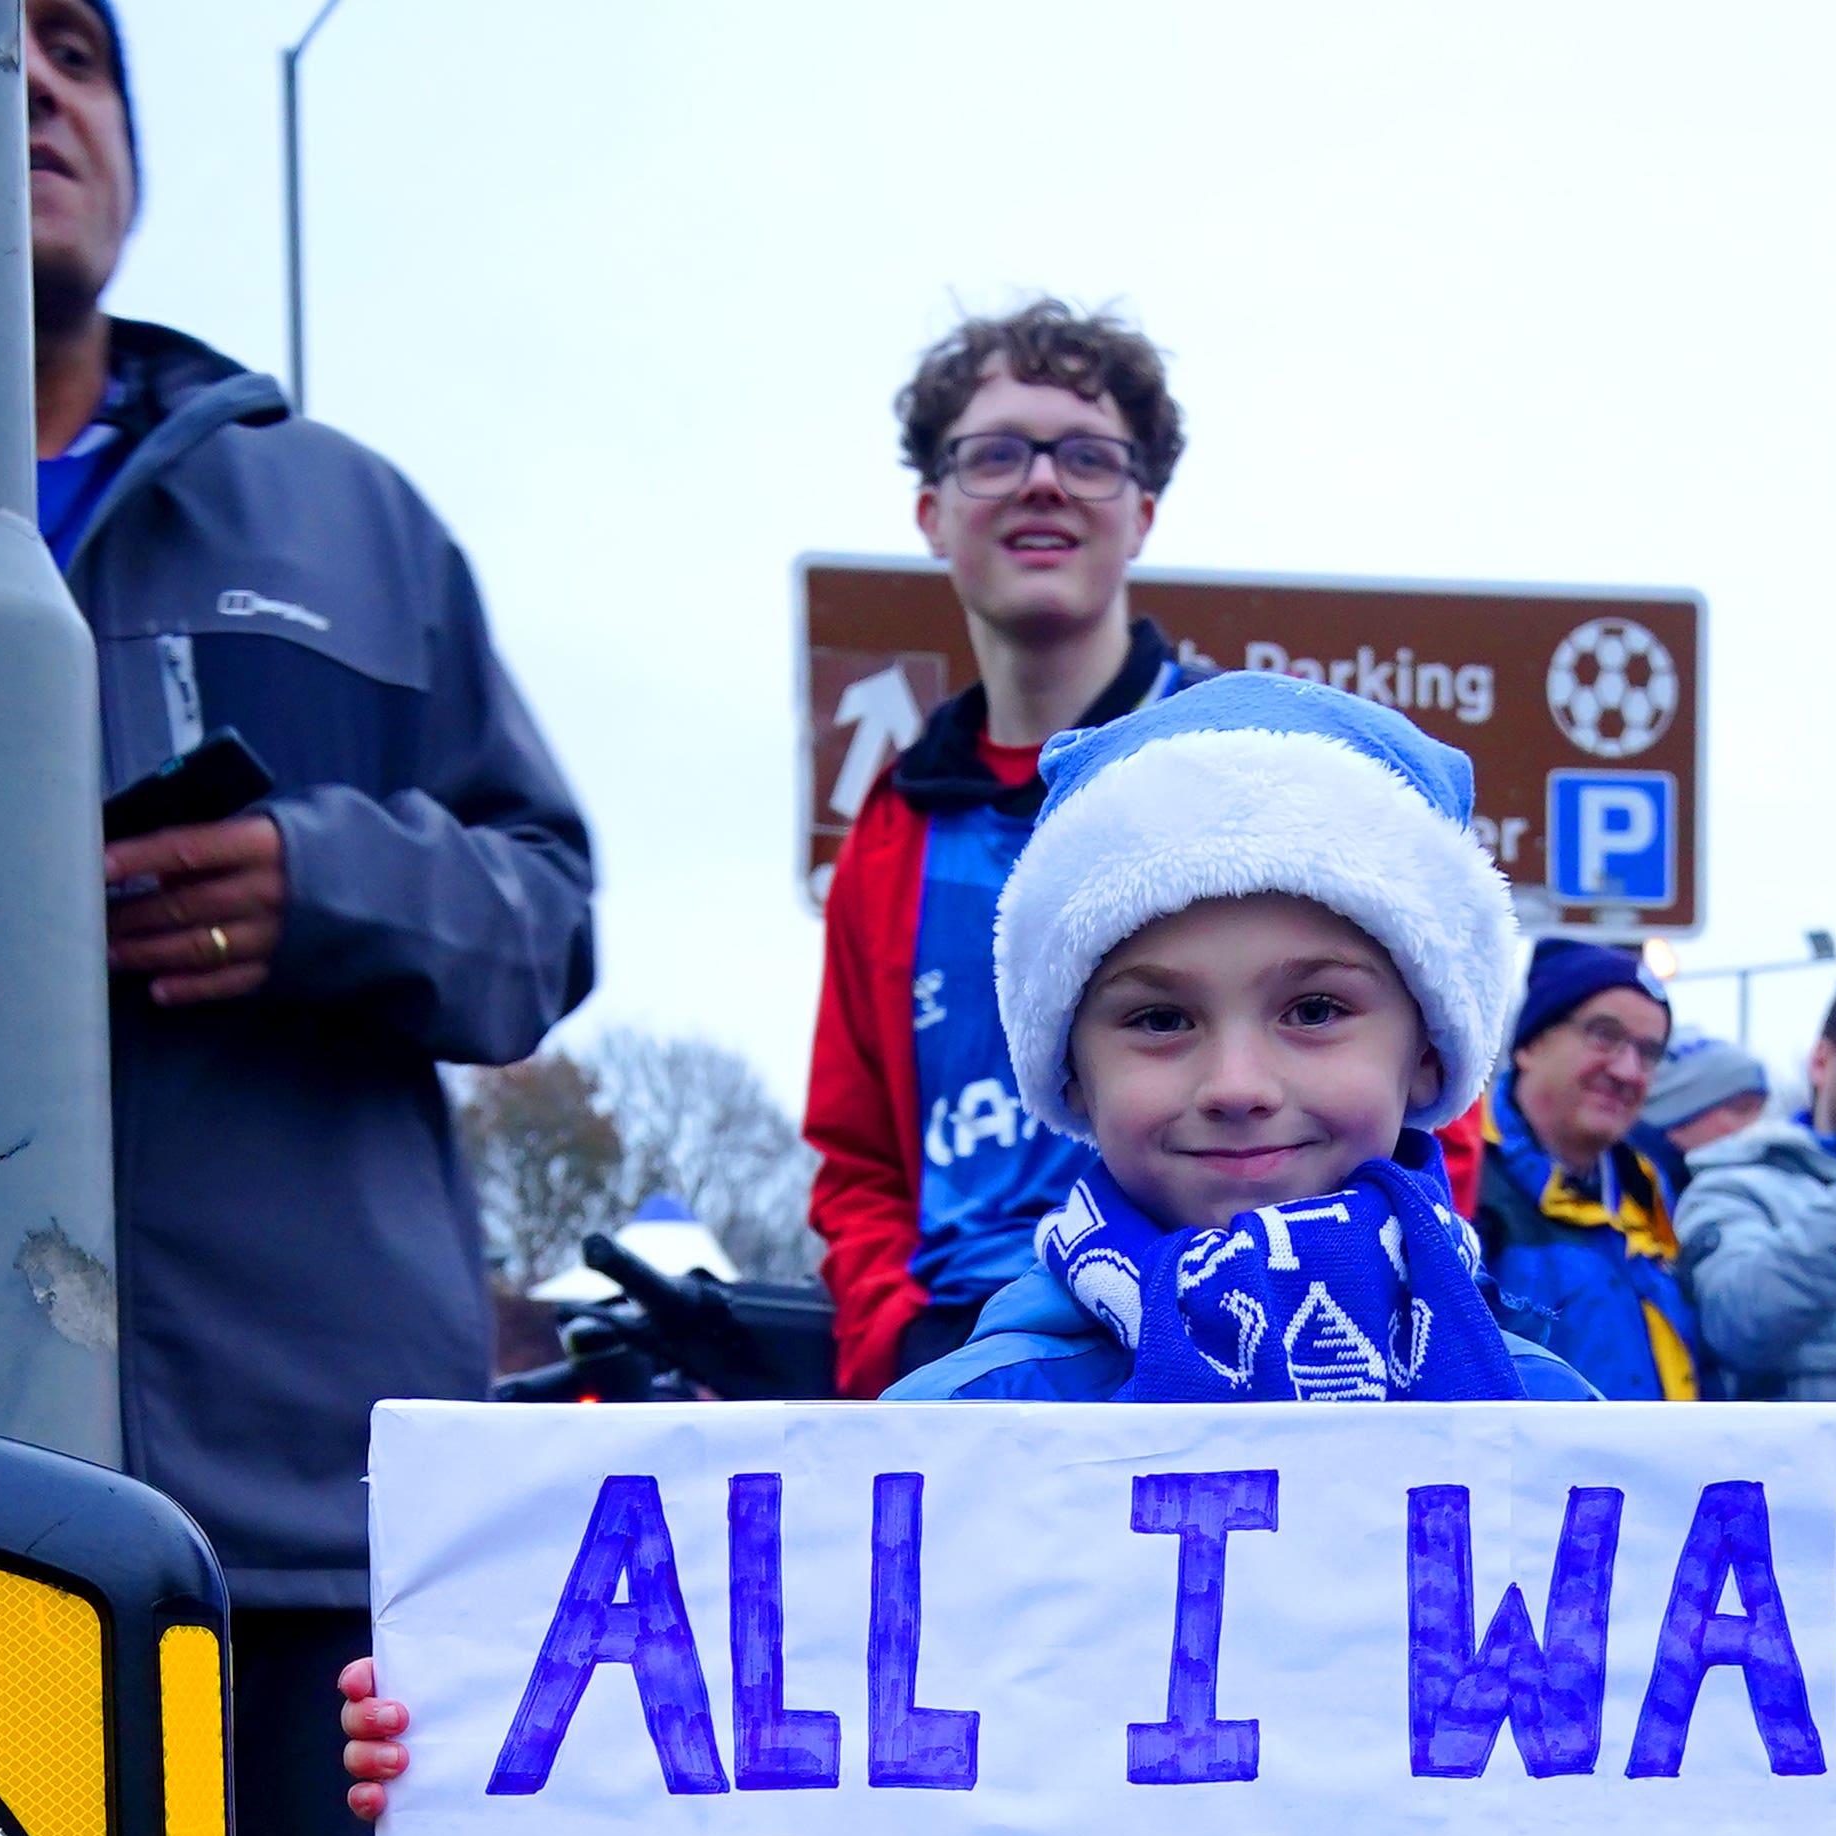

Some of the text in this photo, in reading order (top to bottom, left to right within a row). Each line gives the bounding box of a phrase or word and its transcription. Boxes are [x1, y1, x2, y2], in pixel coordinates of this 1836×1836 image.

[1246, 640, 1495, 724] Parking
[1578, 786, 1657, 893] P
[485, 1471, 981, 1796] ALL
[1127, 1469, 1280, 1785] I
